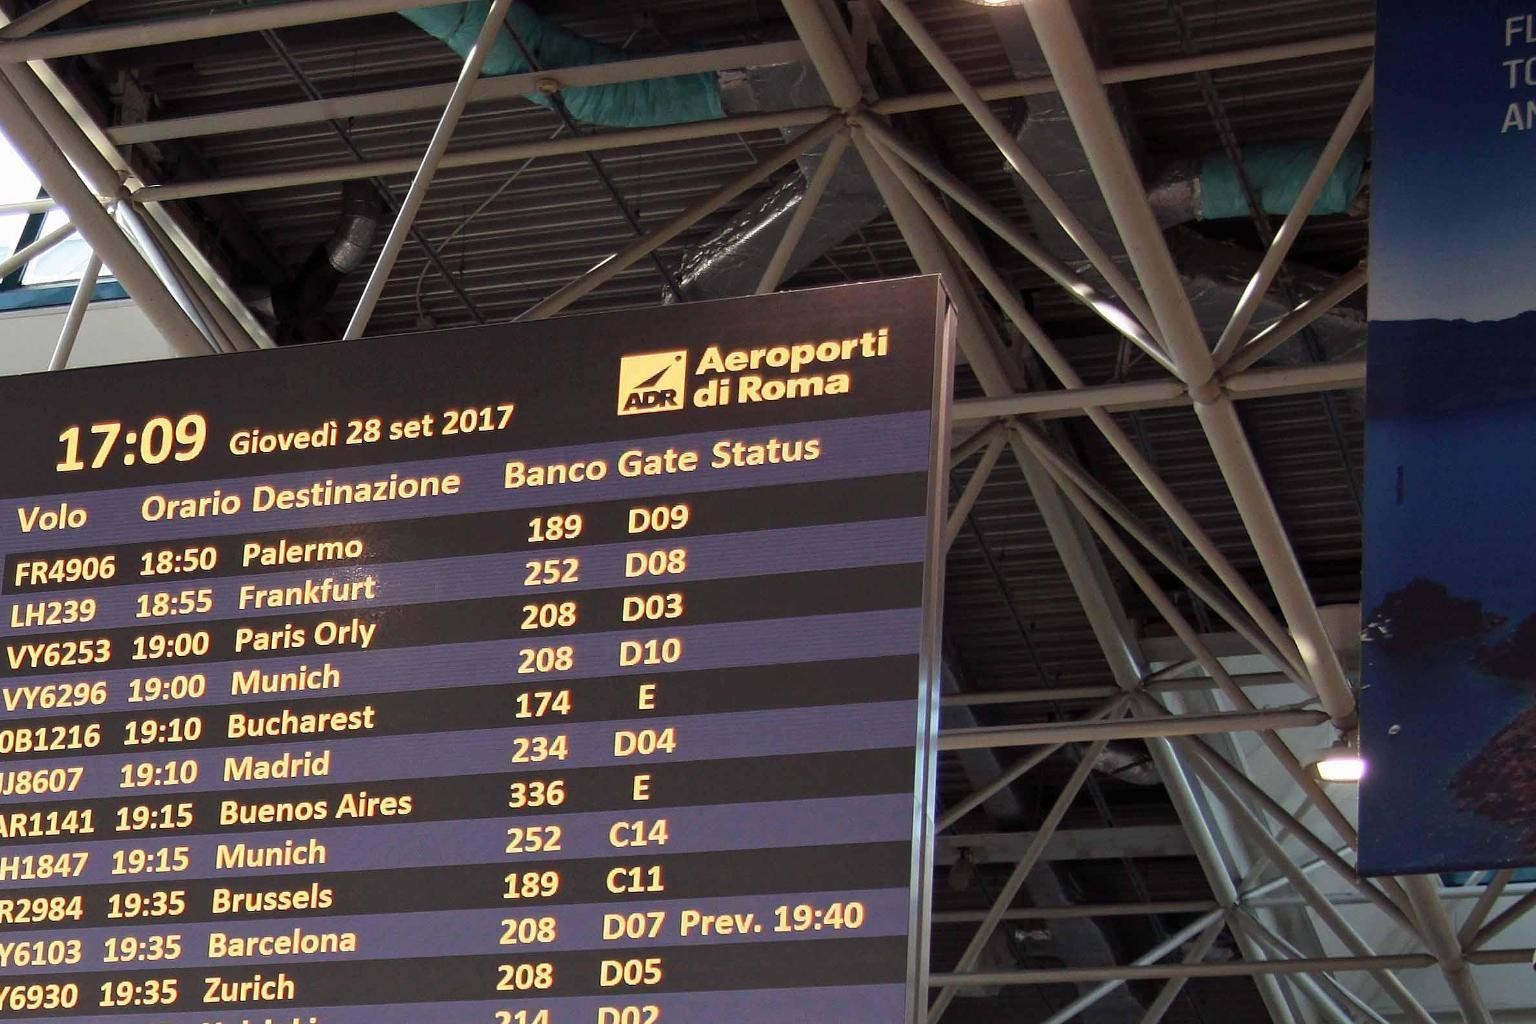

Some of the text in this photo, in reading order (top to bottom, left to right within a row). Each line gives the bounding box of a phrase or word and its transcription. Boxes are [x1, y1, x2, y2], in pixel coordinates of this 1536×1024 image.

[695, 327, 890, 376] Aeroporti
[622, 388, 680, 413] ADR
[692, 372, 851, 408] di Roma
[54, 402, 516, 473] 17:09 Giovedì 28 set 2017
[16, 435, 823, 534] Volo Orario Destinazione Banco Gate Status
[9, 545, 688, 629] LH239 18:55 Frankfurt 252 D08
[1, 635, 684, 713] VY6296 19:00 Munich 208 D10
[118, 758, 200, 790] 19:10
[222, 748, 332, 783] Madrid
[510, 733, 570, 764] 234
[612, 726, 679, 758] D04
[110, 845, 191, 876] 19:15
[214, 837, 328, 871] Munich
[504, 823, 564, 855] 252
[607, 817, 669, 849] C14
[102, 933, 183, 964] 19:35
[207, 928, 359, 959] Barcelona
[497, 915, 558, 946] 208
[601, 909, 667, 942] D07
[679, 907, 764, 937] Prev.
[772, 900, 867, 934] 19:40
